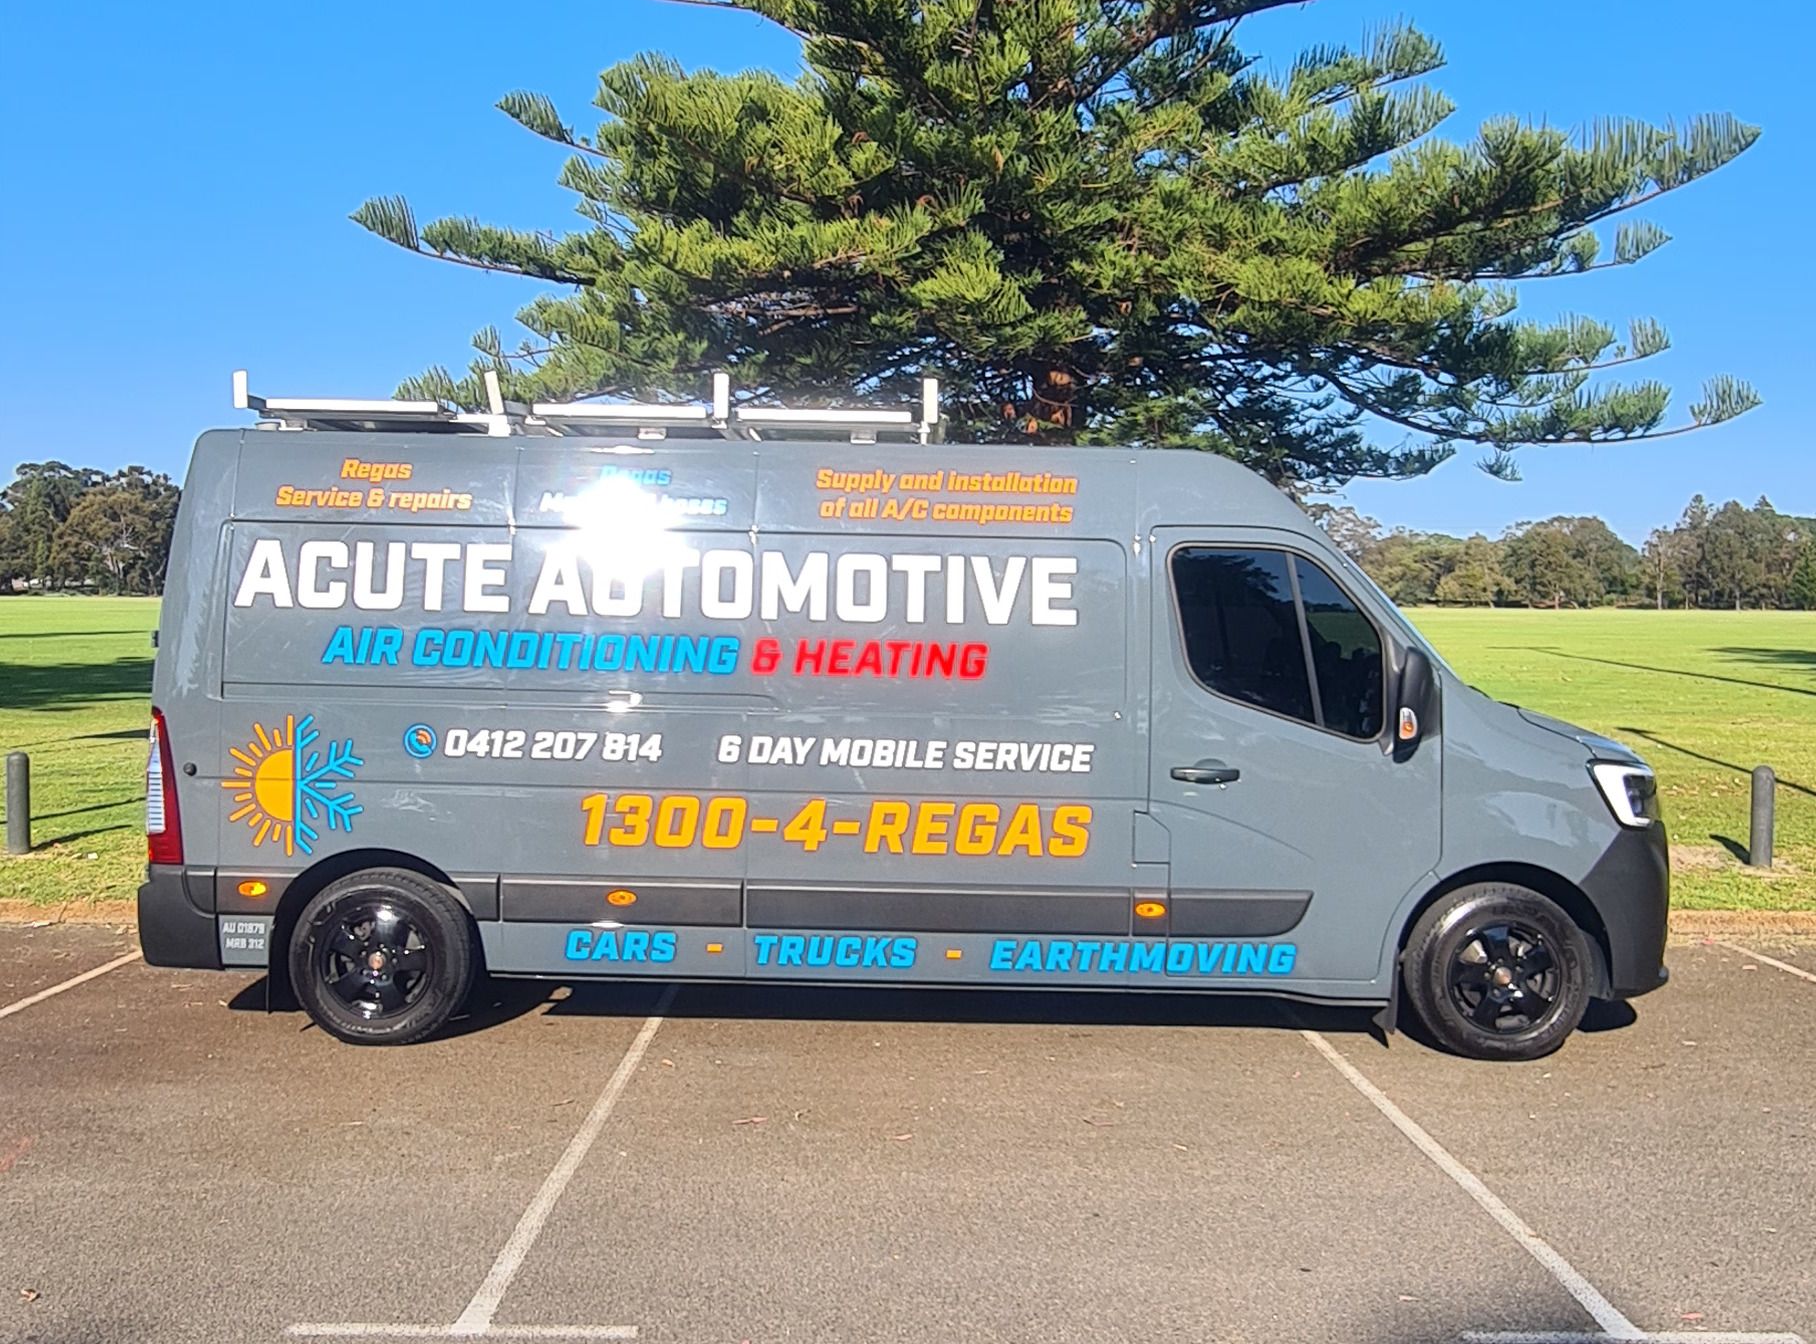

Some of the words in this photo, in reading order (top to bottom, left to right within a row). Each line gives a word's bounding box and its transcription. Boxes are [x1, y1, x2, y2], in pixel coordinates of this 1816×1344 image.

[341, 457, 413, 479] Regas
[816, 469, 896, 493] Supply
[899, 471, 942, 492] and
[948, 472, 1079, 495] installation
[276, 486, 363, 508] Service
[367, 487, 386, 508] &
[389, 488, 472, 512] repairs
[820, 498, 844, 519] of
[848, 499, 878, 518] all
[881, 500, 928, 521] A/C
[932, 503, 1073, 524] components
[233, 539, 513, 613] ACUTE
[527, 544, 1079, 626] AUTOMOTIVE
[321, 626, 404, 666] AIR
[411, 628, 740, 675] CONDITIONING
[750, 636, 783, 677] &
[793, 639, 989, 680] HEATING
[443, 729, 525, 759] 0412
[530, 730, 598, 760] 207
[601, 732, 663, 762] 814
[717, 734, 743, 763] 6
[747, 735, 815, 765] DAY
[820, 737, 947, 769] MOBILE
[952, 741, 1096, 773] SERVICE
[580, 792, 1093, 858] 1300-4-REGAS
[222, 922, 236, 934] AU
[565, 929, 678, 963] CARS
[754, 935, 918, 969] TRUCKS
[989, 939, 1297, 976] EARTHMOVING
